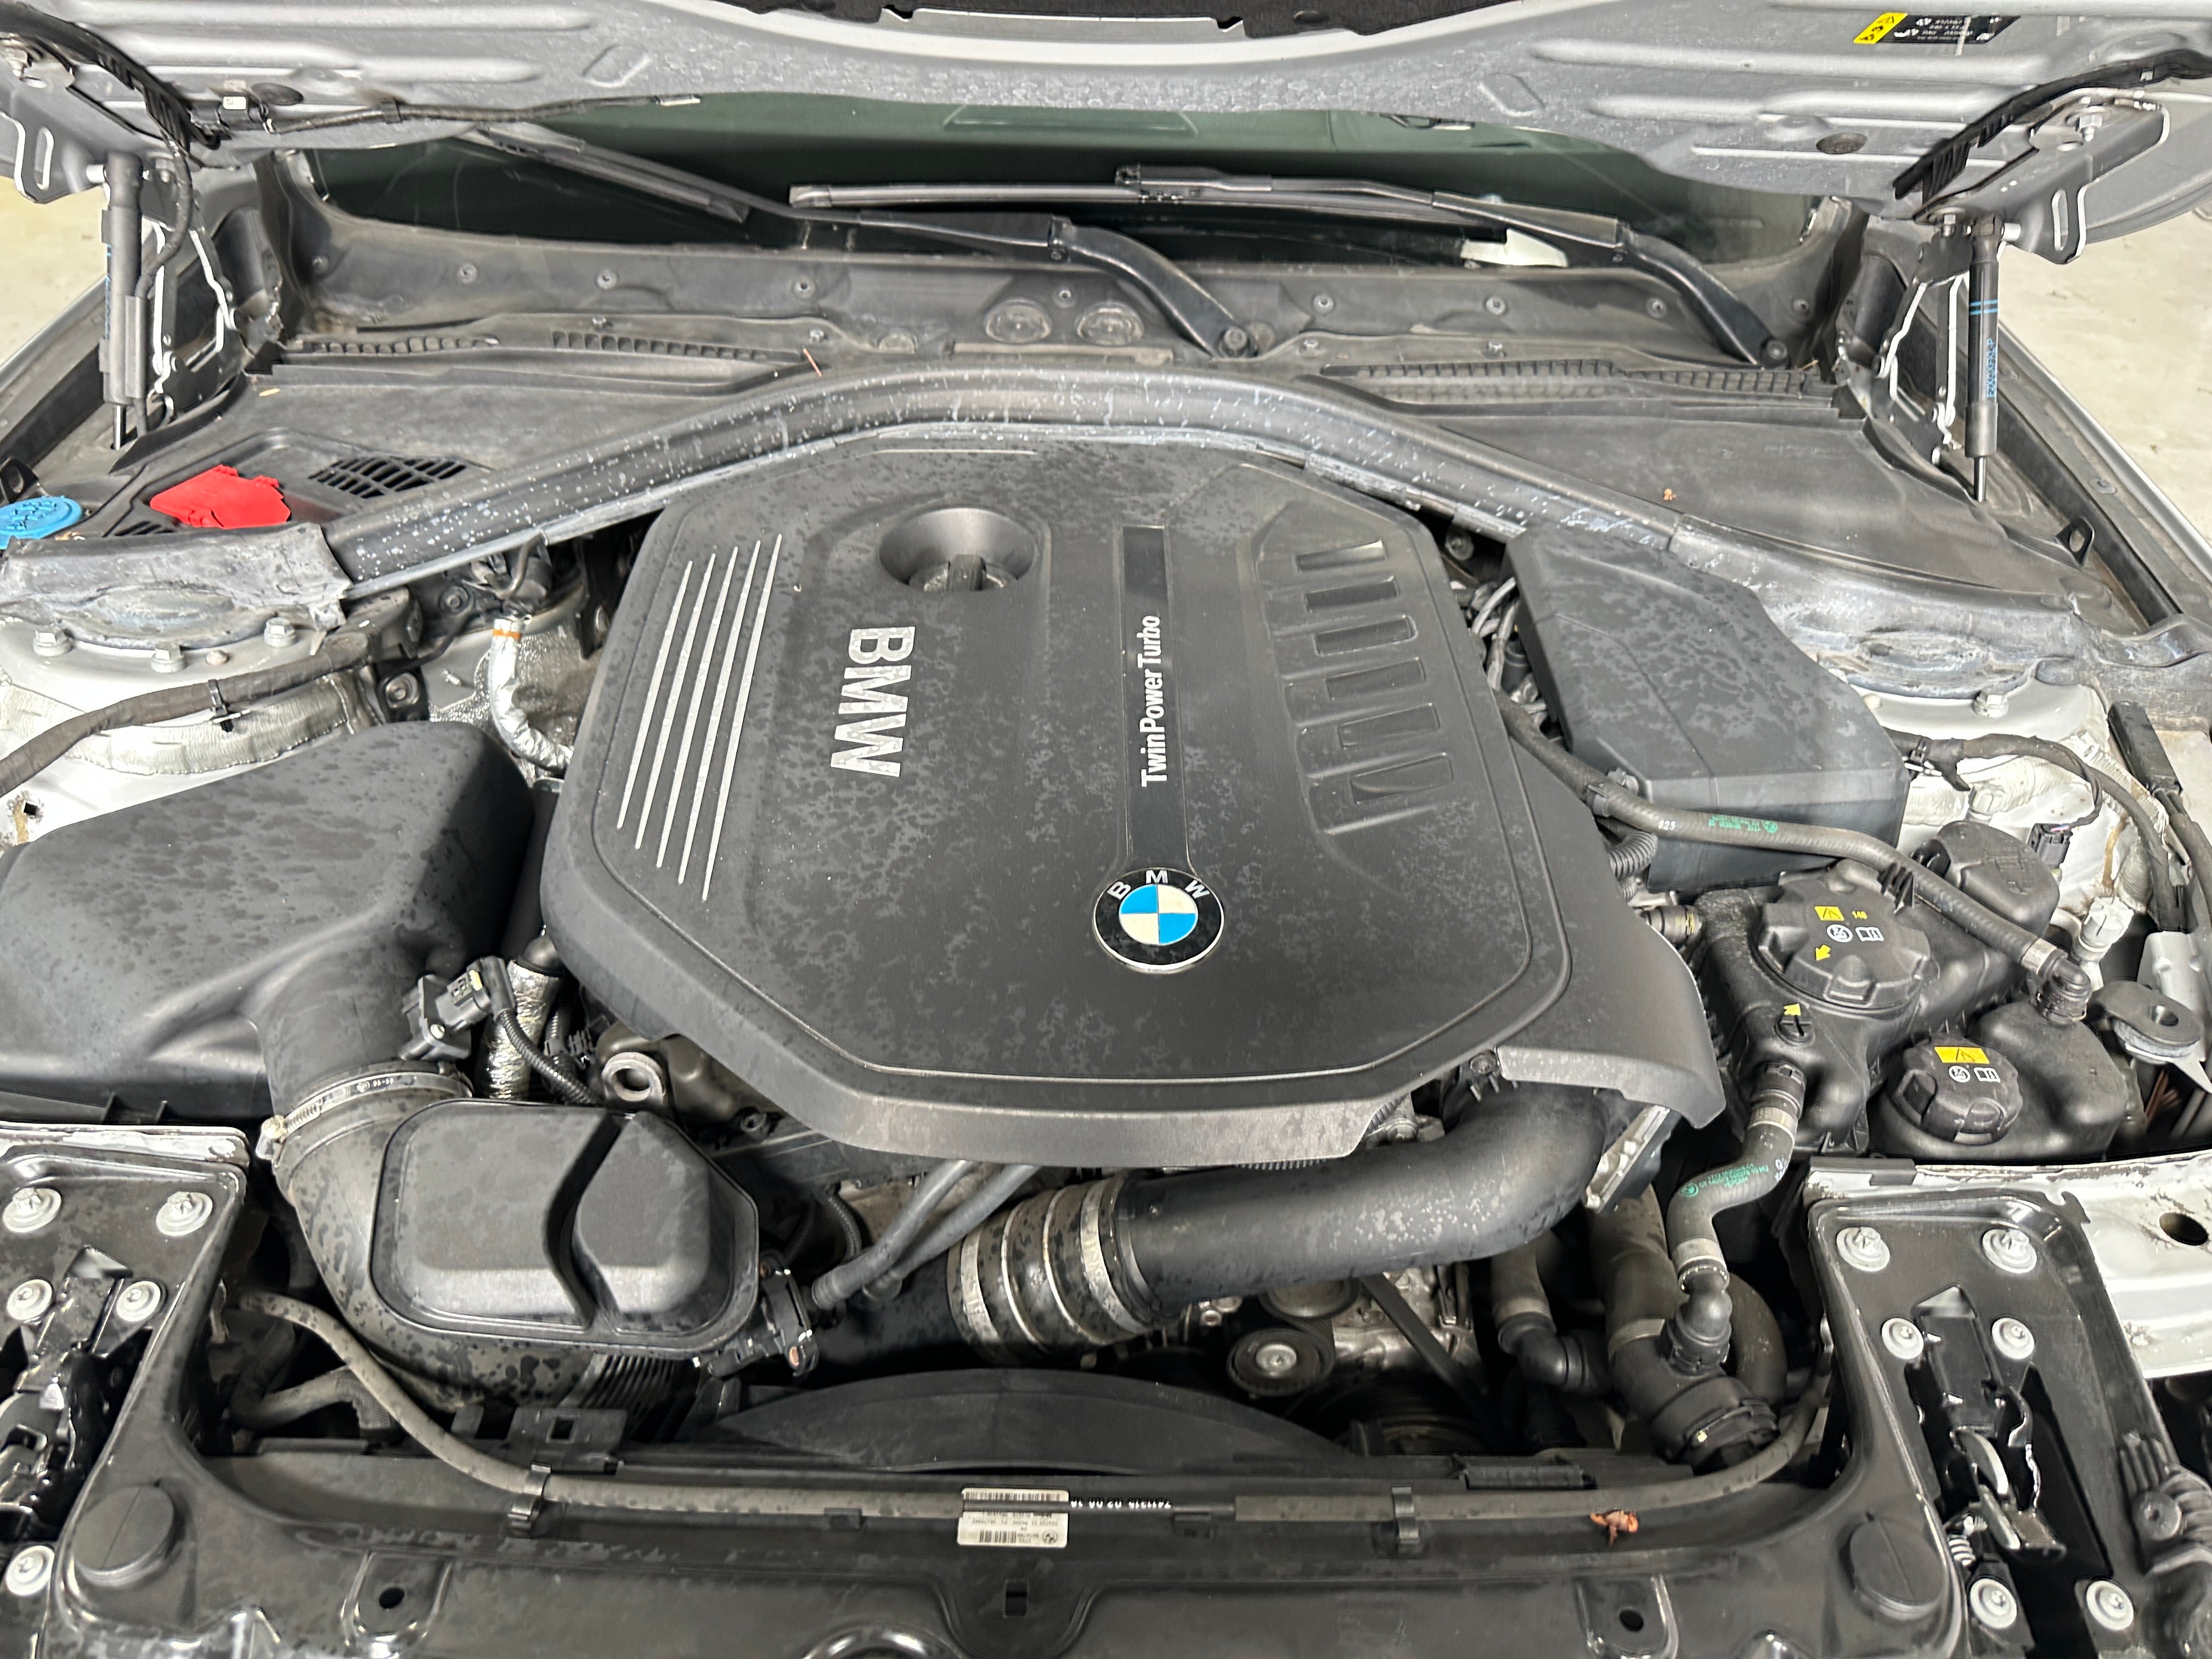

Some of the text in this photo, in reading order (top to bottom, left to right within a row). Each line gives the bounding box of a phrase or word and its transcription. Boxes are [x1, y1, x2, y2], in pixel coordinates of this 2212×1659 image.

[830, 625, 917, 778] BMW
[1136, 615, 1167, 787] TwinPower Turbo
[1107, 870, 1210, 900] BMW
